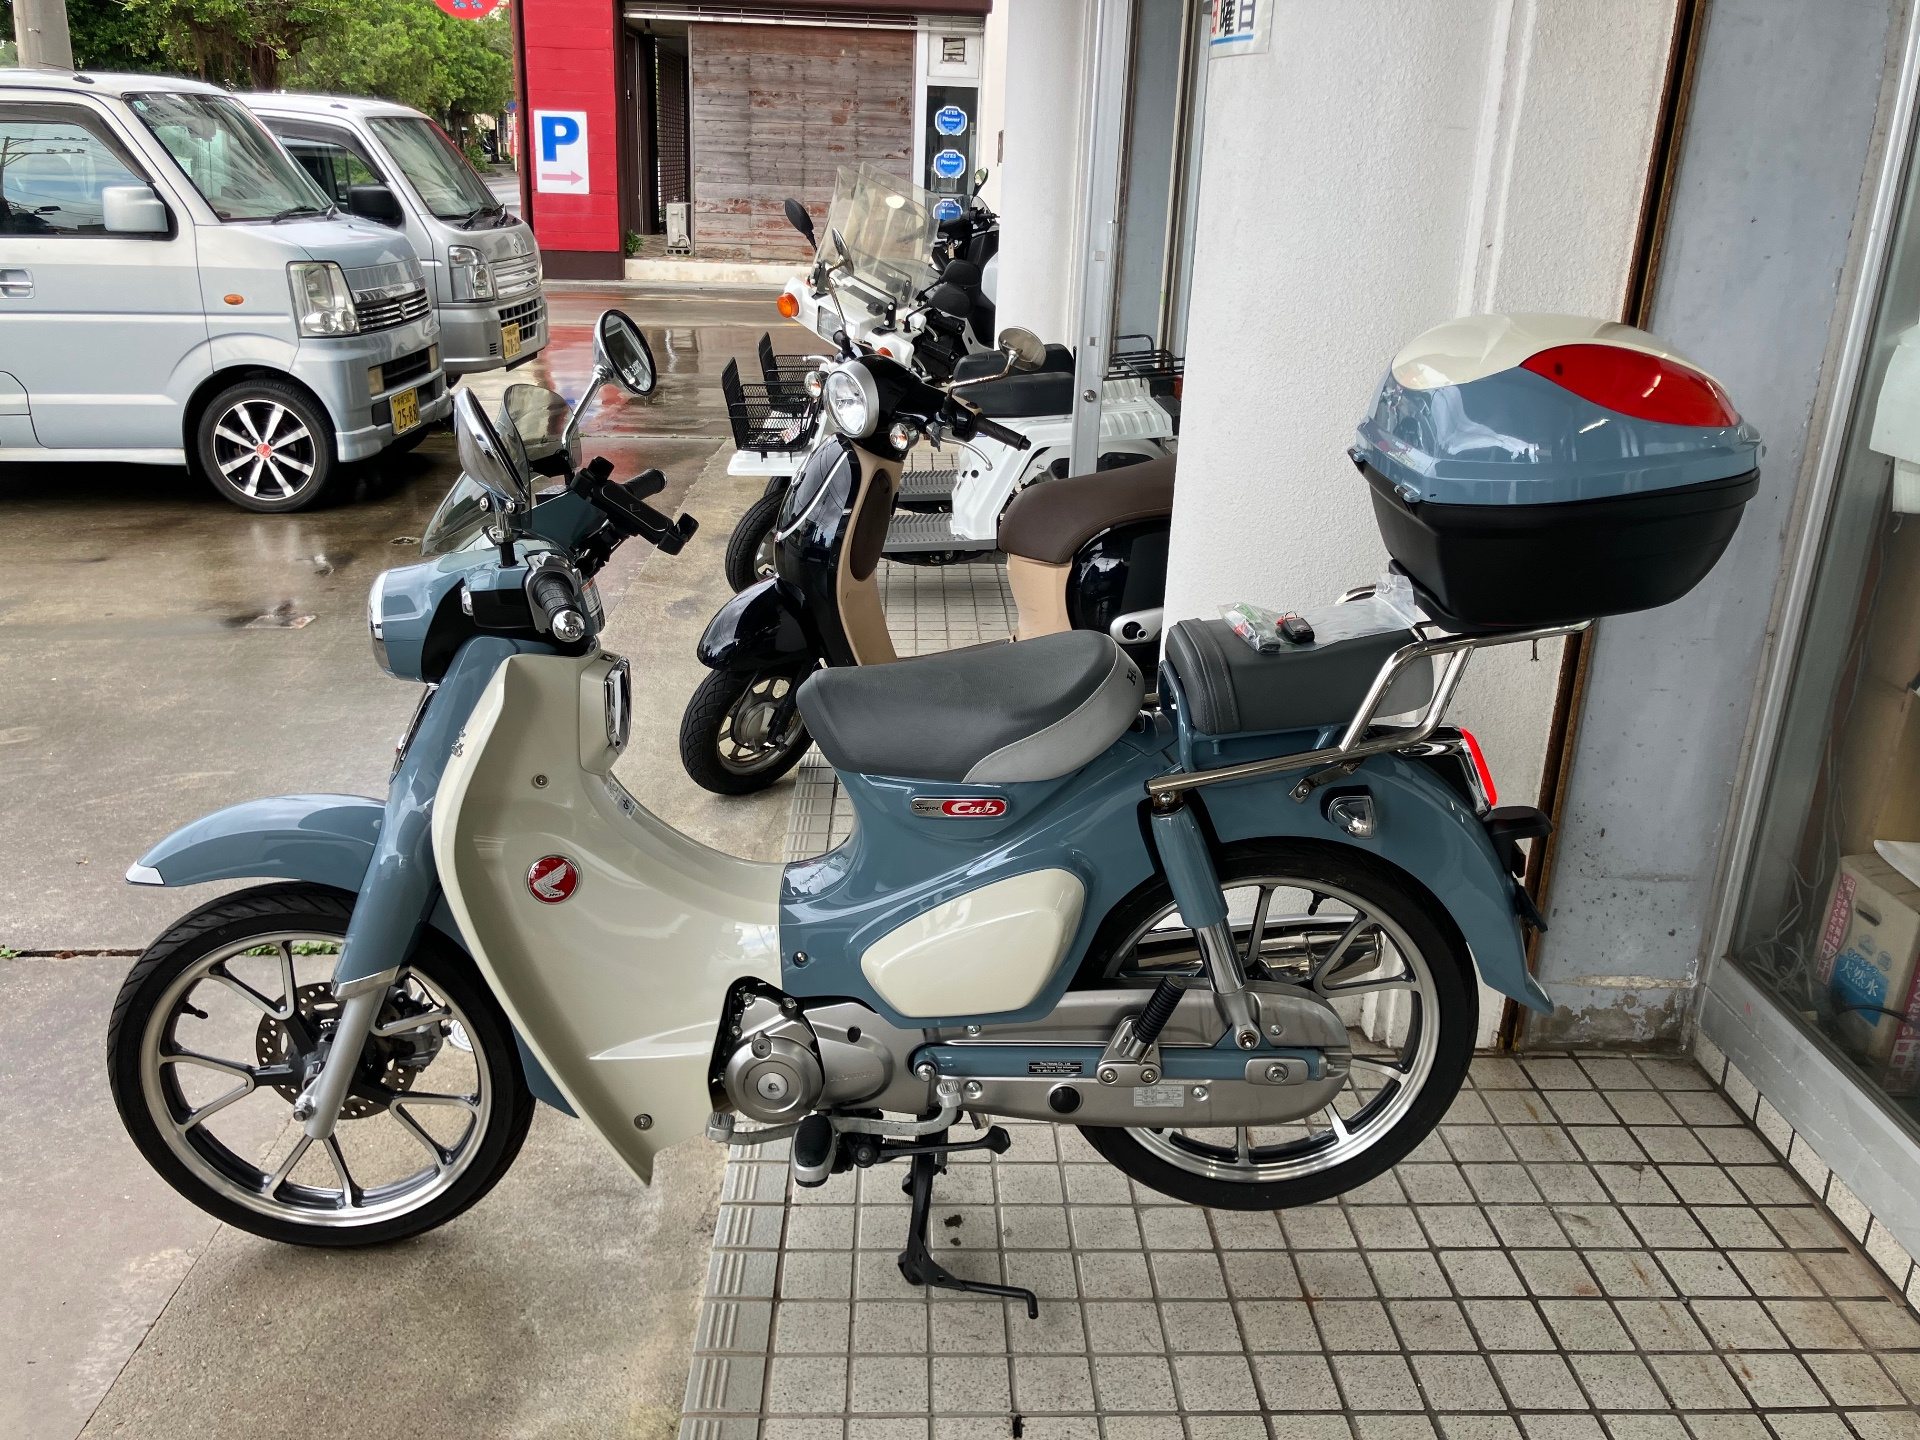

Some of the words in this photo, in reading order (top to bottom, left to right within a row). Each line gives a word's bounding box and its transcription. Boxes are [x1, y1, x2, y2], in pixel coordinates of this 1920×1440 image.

[541, 116, 580, 162] P
[914, 803, 941, 812] Super
[951, 801, 998, 814] Cub
[1839, 960, 1879, 997] 天然水
